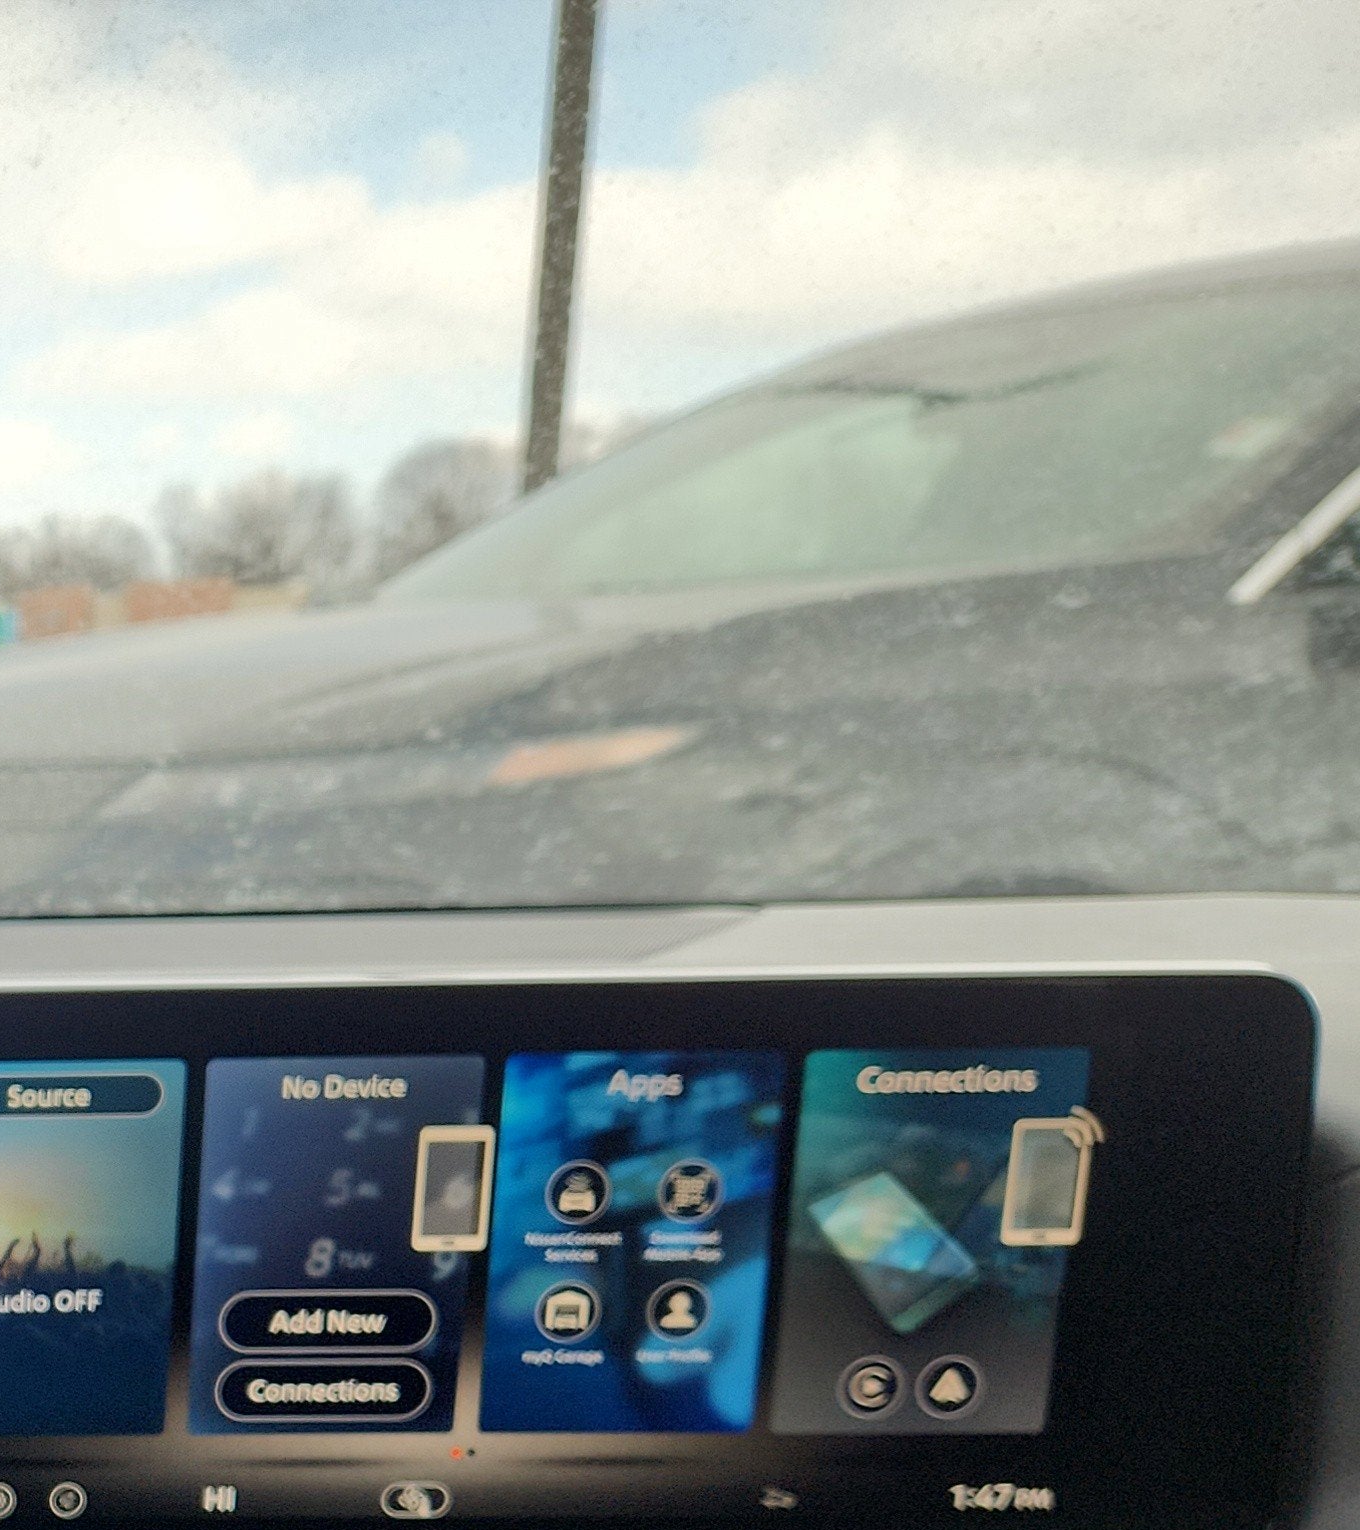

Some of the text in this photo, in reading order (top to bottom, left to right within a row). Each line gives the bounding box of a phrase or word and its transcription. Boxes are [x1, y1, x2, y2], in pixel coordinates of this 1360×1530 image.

[282, 1073, 407, 1101] No Device
[606, 1069, 684, 1101] Apps
[856, 1065, 1038, 1095] Connections
[7, 1084, 92, 1108] Source
[54, 1288, 103, 1313] OFF
[268, 1309, 387, 1334] Add New
[246, 1378, 401, 1403] Connections
